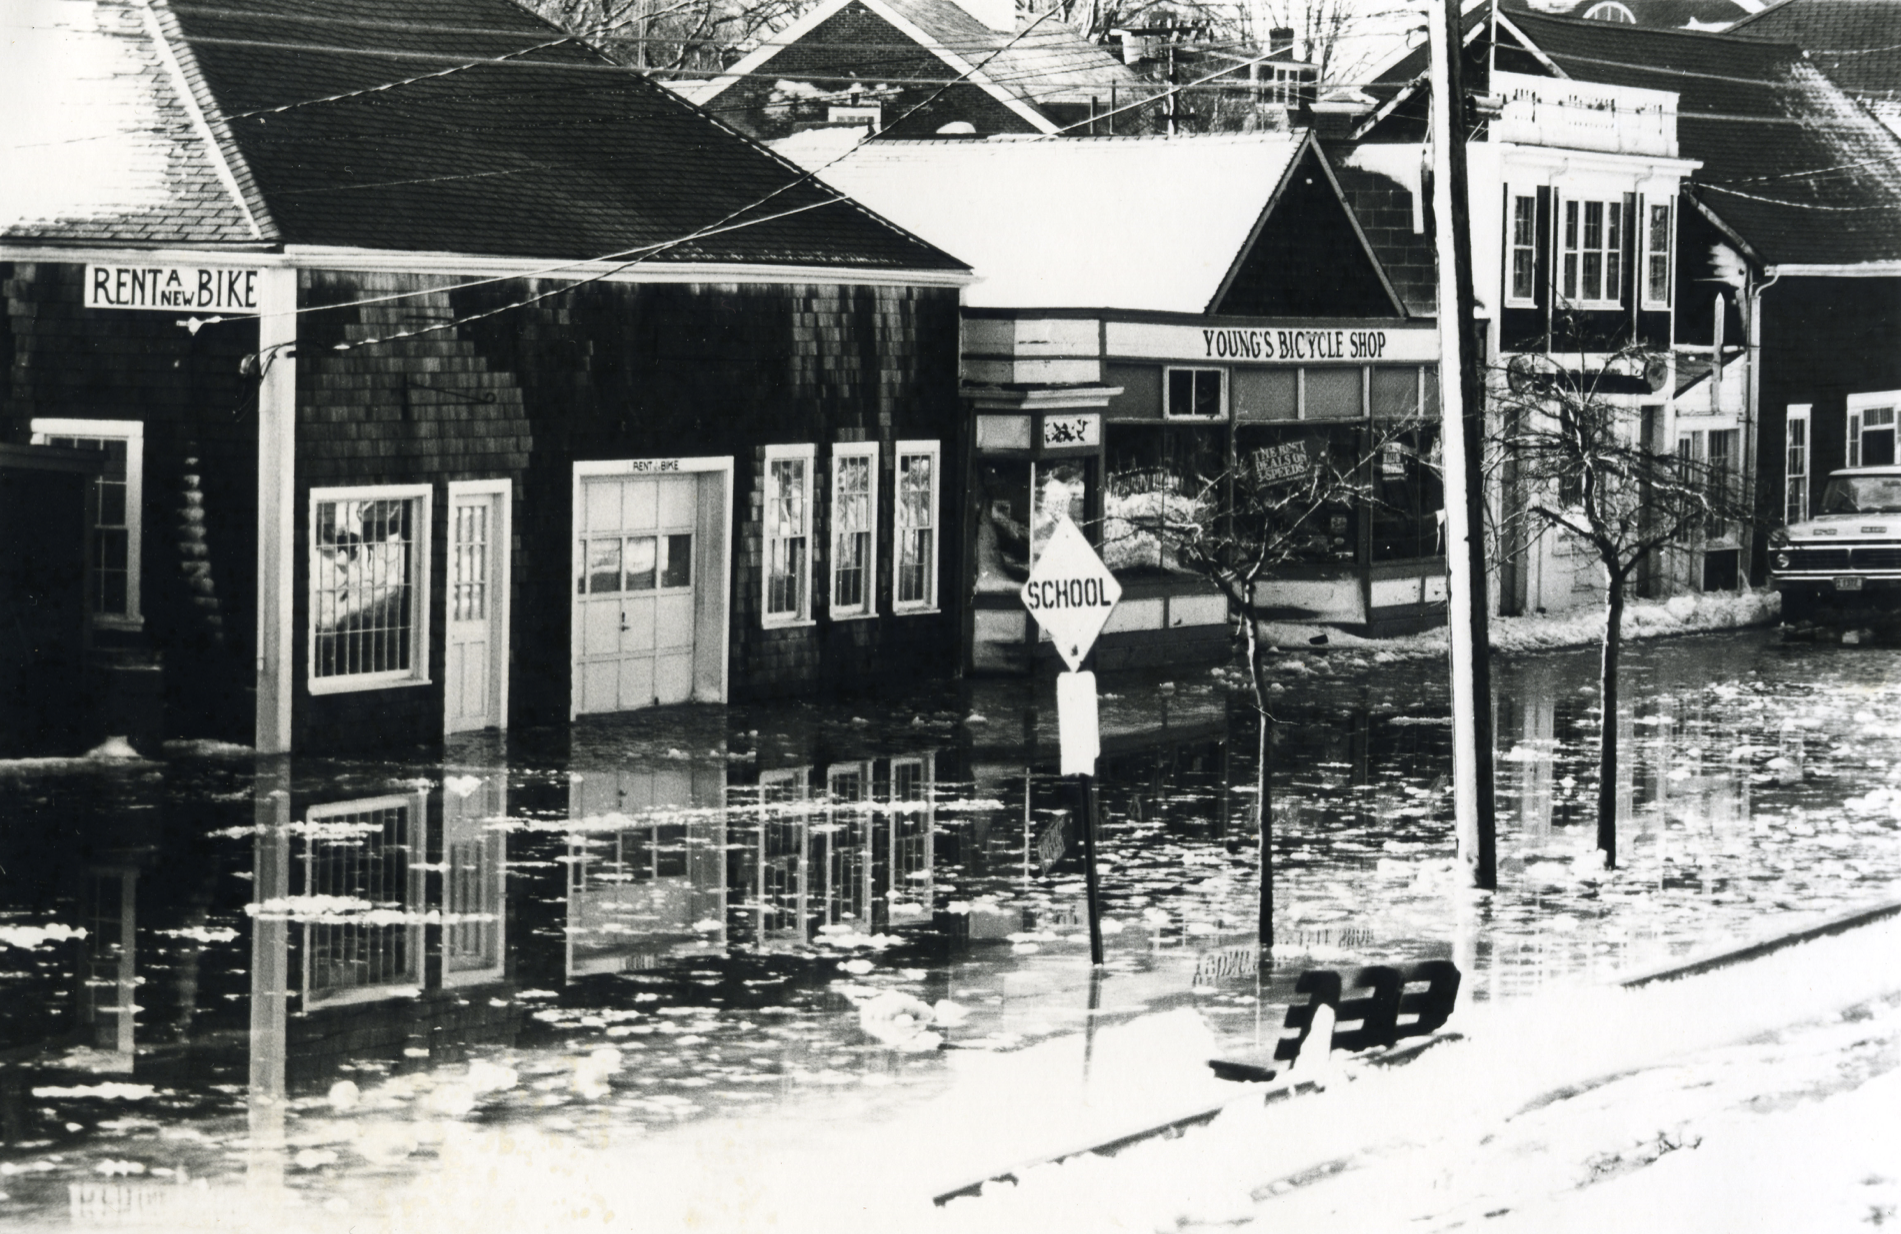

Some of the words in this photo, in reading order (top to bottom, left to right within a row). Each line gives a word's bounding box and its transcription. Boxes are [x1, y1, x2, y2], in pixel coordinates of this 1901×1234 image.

[93, 268, 162, 306] RENT
[166, 269, 182, 287] A
[197, 269, 258, 308] BIKE
[161, 290, 194, 306] NEW
[1203, 330, 1274, 359] YOUNG'S
[1277, 330, 1344, 359] BICYCLE
[1350, 331, 1386, 358] SHOP
[1252, 446, 1277, 461] THE
[633, 461, 653, 471] RENT
[661, 460, 679, 471] BIKE
[1255, 454, 1291, 472] DEALS
[1028, 577, 1111, 610] SCHOOL
